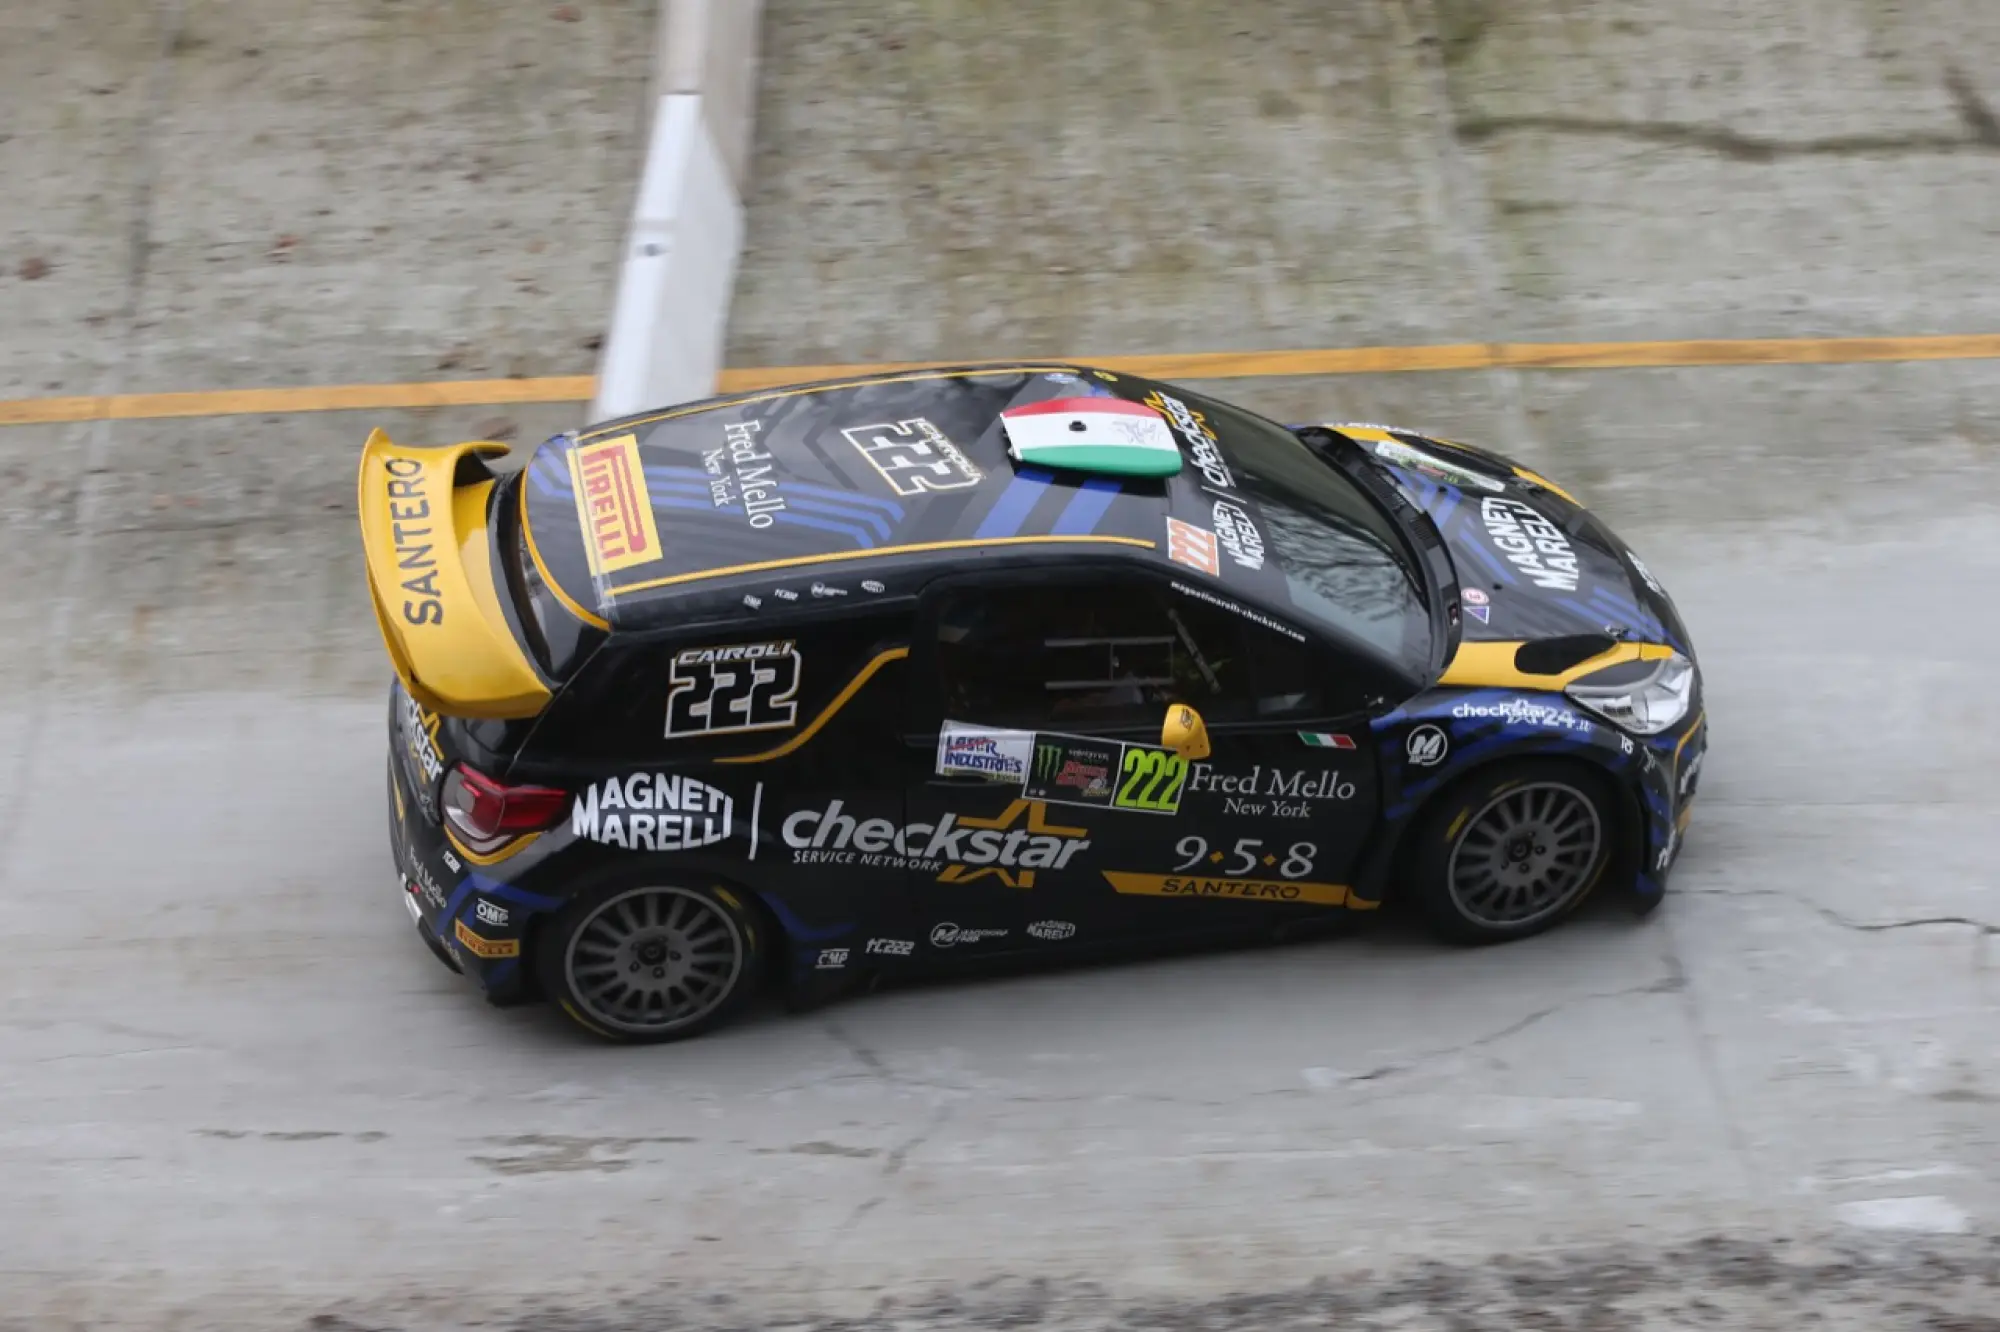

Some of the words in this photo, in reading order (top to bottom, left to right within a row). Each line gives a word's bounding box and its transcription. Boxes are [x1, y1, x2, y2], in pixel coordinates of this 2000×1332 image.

[702, 447, 725, 476] New
[724, 419, 772, 465] Fred
[840, 417, 982, 496] 222
[581, 444, 647, 561] PIRELLI
[709, 476, 737, 508] York
[737, 463, 787, 530] Mello
[385, 456, 444, 626] SANTERO
[1481, 496, 1545, 586] MAGNETI
[677, 639, 796, 666] CAIROLI
[664, 648, 802, 739] 222
[572, 772, 734, 818] MAGNETI
[1115, 748, 1189, 812] 222
[1189, 763, 1260, 795] Fred
[1269, 768, 1356, 800] Mello
[572, 806, 734, 851] MARELLI
[1223, 797, 1266, 817] New
[1268, 799, 1312, 819] York
[782, 799, 1091, 871] checkstar
[793, 850, 854, 865] SERVICE
[860, 854, 942, 873] NETWORK
[1161, 877, 1301, 901] SANTERO
